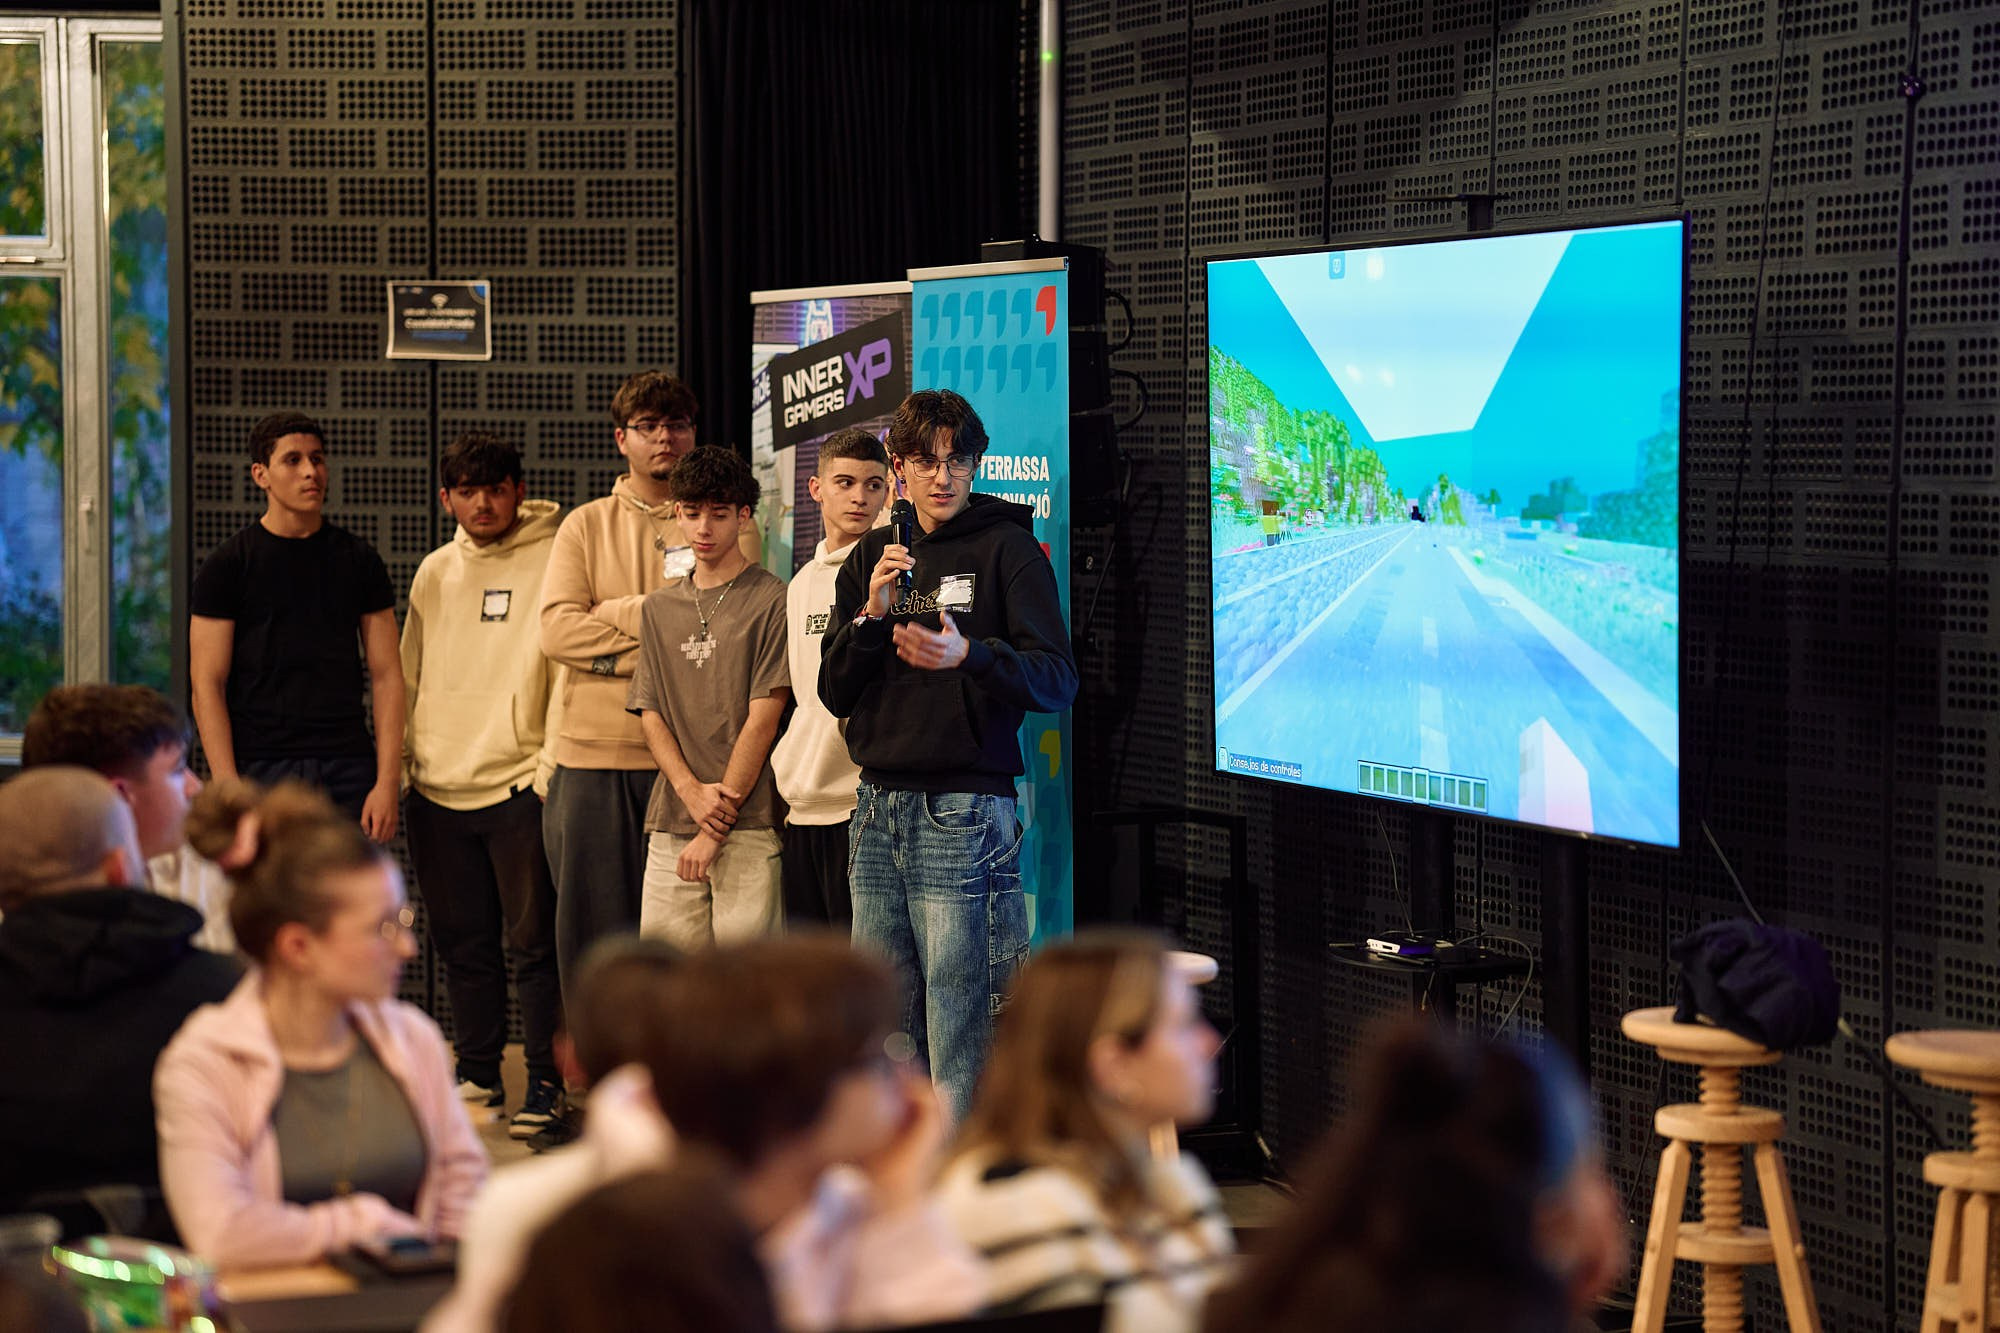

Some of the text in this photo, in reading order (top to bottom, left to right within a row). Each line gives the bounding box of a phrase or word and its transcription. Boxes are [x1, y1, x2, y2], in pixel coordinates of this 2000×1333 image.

[782, 355, 843, 404] INNER
[843, 338, 892, 406] XP
[784, 388, 845, 429] GAMERS
[980, 455, 1050, 482] TERRASSA
[1229, 755, 1302, 778] Consejos de controles
